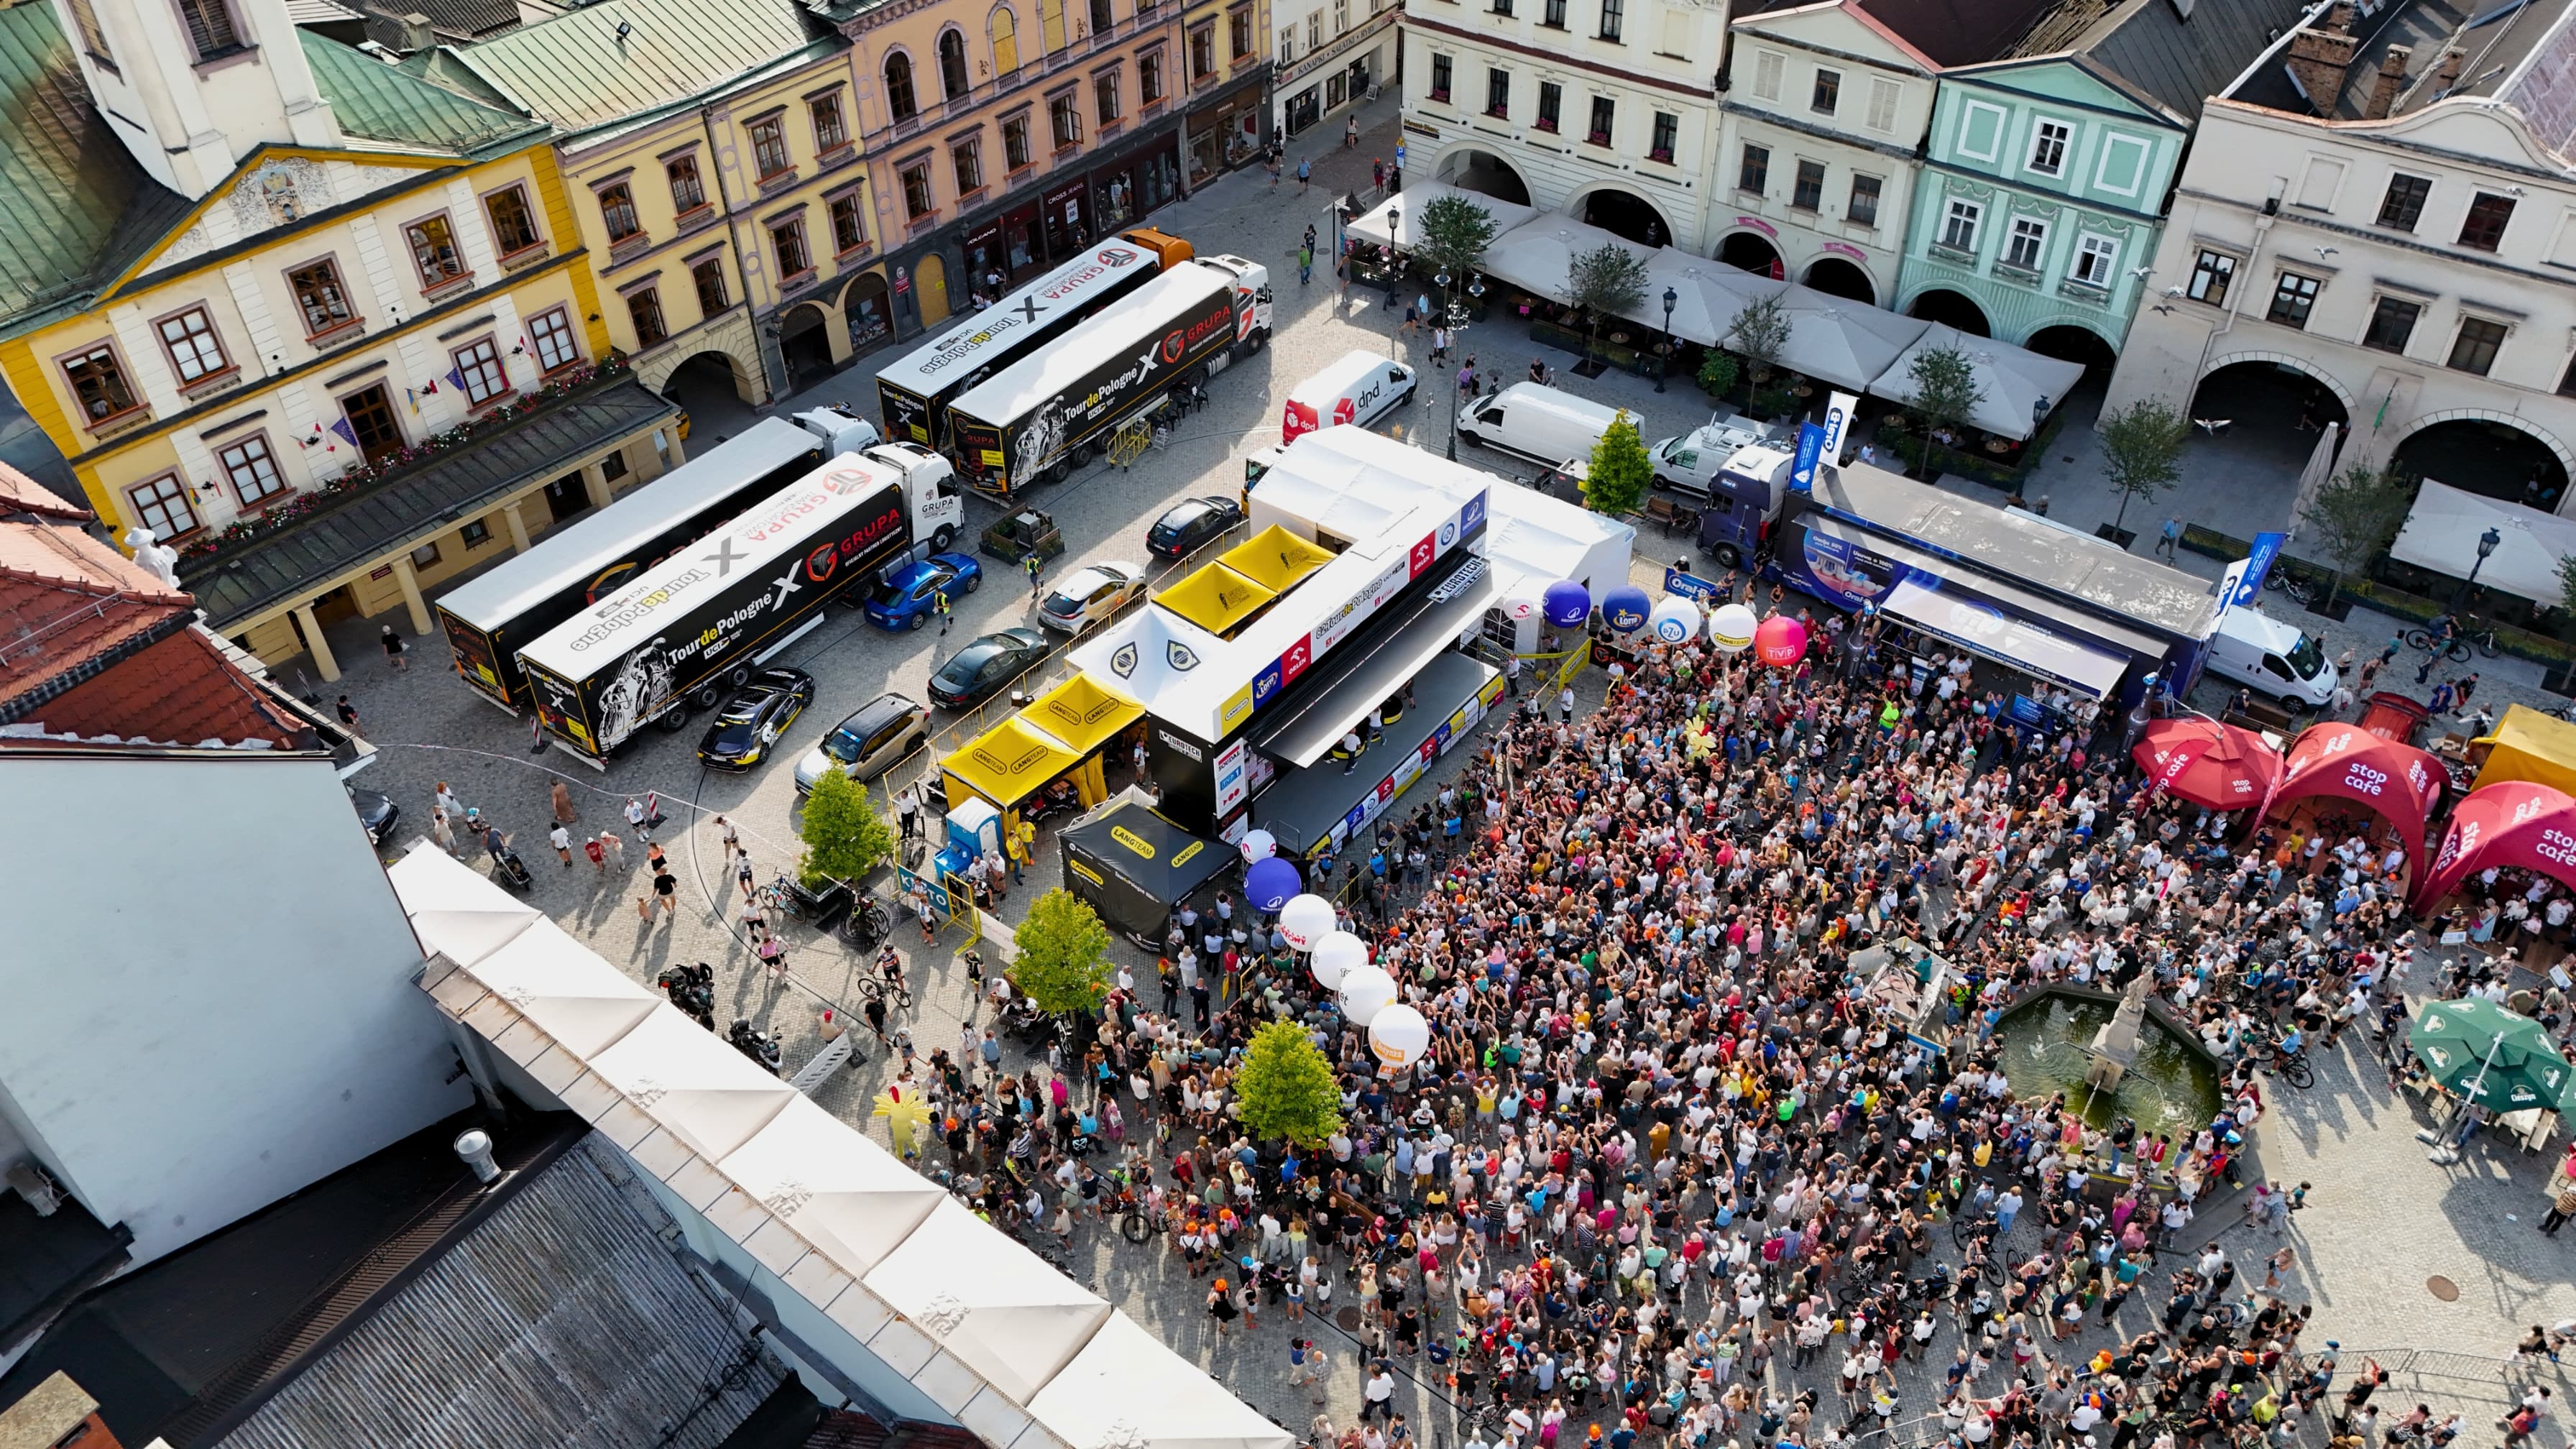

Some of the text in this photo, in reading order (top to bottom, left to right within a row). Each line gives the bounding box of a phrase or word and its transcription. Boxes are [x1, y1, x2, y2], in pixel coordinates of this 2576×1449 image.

[1297, 54, 1325, 75] KANAPKI
[1361, 24, 1375, 38] RYBY
[1048, 182, 1084, 206] CROSS JEANS
[1045, 267, 1105, 300] GRUPA
[1187, 305, 1230, 340] GRUPA
[881, 387, 925, 412] TourdePologne
[1064, 367, 1138, 422] TourdePologne
[1358, 381, 1380, 408] dpd
[1300, 420, 1316, 431] dpd
[1825, 411, 1841, 450] Oral-B
[921, 497, 954, 514] GRUPA
[748, 494, 828, 543] GRUPA
[840, 508, 900, 552] GRUPA
[1414, 555, 1430, 571] ORLEN
[1440, 558, 1483, 594] EUROTECH
[1671, 577, 1708, 597] Oral-B
[571, 568, 712, 651] TourdePologne
[1619, 615, 1638, 626] LOTTO
[668, 591, 773, 666] TourdePologne
[1663, 627, 1680, 638] PZU
[1716, 635, 1750, 645] LANGTEAM
[1768, 646, 1795, 659] TVP
[1289, 657, 1307, 675] ORLEN
[526, 665, 576, 698] TourdePologne
[1260, 677, 1276, 694] LOTTO
[1052, 702, 1080, 723] LANGTEAM
[1087, 699, 1117, 722] LANGTEAM
[1168, 735, 1201, 757] EUROTECH
[975, 750, 1006, 773] LANGTEAM
[1013, 747, 1046, 772] LANGTEAM
[1218, 750, 1241, 771] SOUDAL
[2167, 753, 2189, 777] cafe
[2409, 759, 2422, 783] stop
[2232, 779, 2250, 788] stop
[2350, 762, 2387, 784] stop
[2235, 784, 2253, 794] cafe
[2344, 775, 2381, 796] cafe
[1113, 828, 1154, 857] LANGTEAM
[2542, 828, 2576, 855] stop
[1173, 842, 1202, 865] LANGTEAM
[2536, 842, 2576, 867] cafe
[2460, 1079, 2488, 1097] Ciezyn
